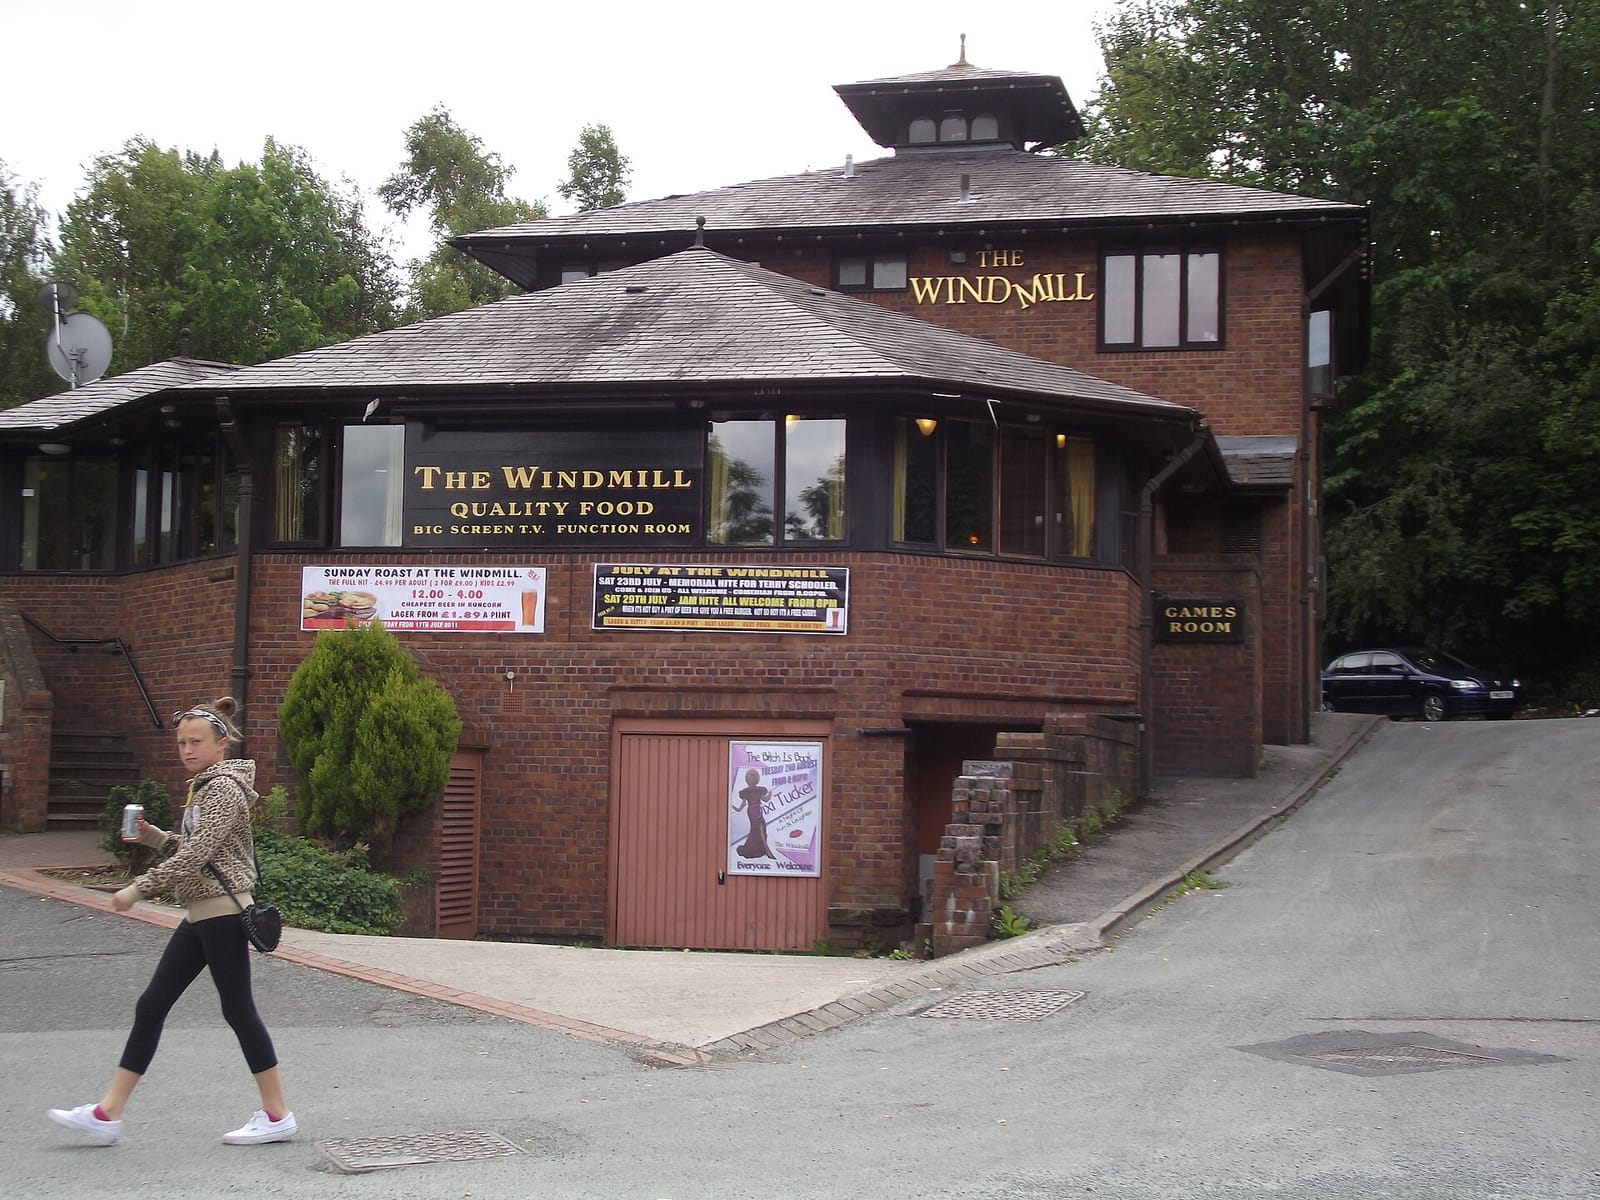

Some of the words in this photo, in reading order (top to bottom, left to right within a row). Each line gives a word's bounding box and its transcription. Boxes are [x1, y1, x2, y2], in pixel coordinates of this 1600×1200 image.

[976, 250, 1024, 268] THE
[909, 273, 1095, 309] WINDMILL
[450, 502, 569, 519] QUALITY
[579, 501, 654, 516] FOOD
[413, 525, 443, 535] BIG
[450, 525, 514, 535] SCREEN
[519, 525, 545, 535] T.V.
[557, 524, 639, 534] FUNCTION
[645, 524, 691, 534] ROOM
[324, 568, 371, 577] SUNDAY
[374, 568, 413, 578] ROAST
[416, 569, 430, 578] AT
[434, 569, 456, 578] THE
[460, 569, 522, 578] WINDMILL.
[611, 566, 654, 575] JULY
[657, 567, 682, 576] AT
[685, 567, 723, 576] THE
[598, 577, 616, 586] SAT
[617, 577, 641, 586] 23RD
[642, 578, 662, 587] JULY
[668, 578, 716, 587] MEMORIAL
[718, 579, 738, 588] NITE
[739, 580, 757, 588] FOR
[758, 580, 787, 589] TERRY
[412, 589, 444, 599] 12.00
[456, 590, 483, 599] 4.00
[604, 594, 622, 604] SAT
[622, 595, 647, 604] 29TH
[648, 595, 668, 605] JULY
[678, 596, 697, 605] JAM
[699, 596, 719, 606] NITE
[722, 596, 738, 606] ALL
[739, 597, 785, 607] WELCOME
[788, 598, 815, 607] FROM
[816, 598, 838, 608] 8PM
[391, 610, 415, 618] LAGER
[441, 611, 481, 619] £1.89
[1165, 607, 1237, 618] GAMES
[1170, 622, 1231, 633] ROOM
[746, 751, 760, 763] The
[762, 751, 780, 762] Bitch
[783, 752, 792, 762] Is
[774, 781, 814, 807] Tucker
[736, 861, 771, 871] Everyone
[776, 862, 814, 871] Welcome
